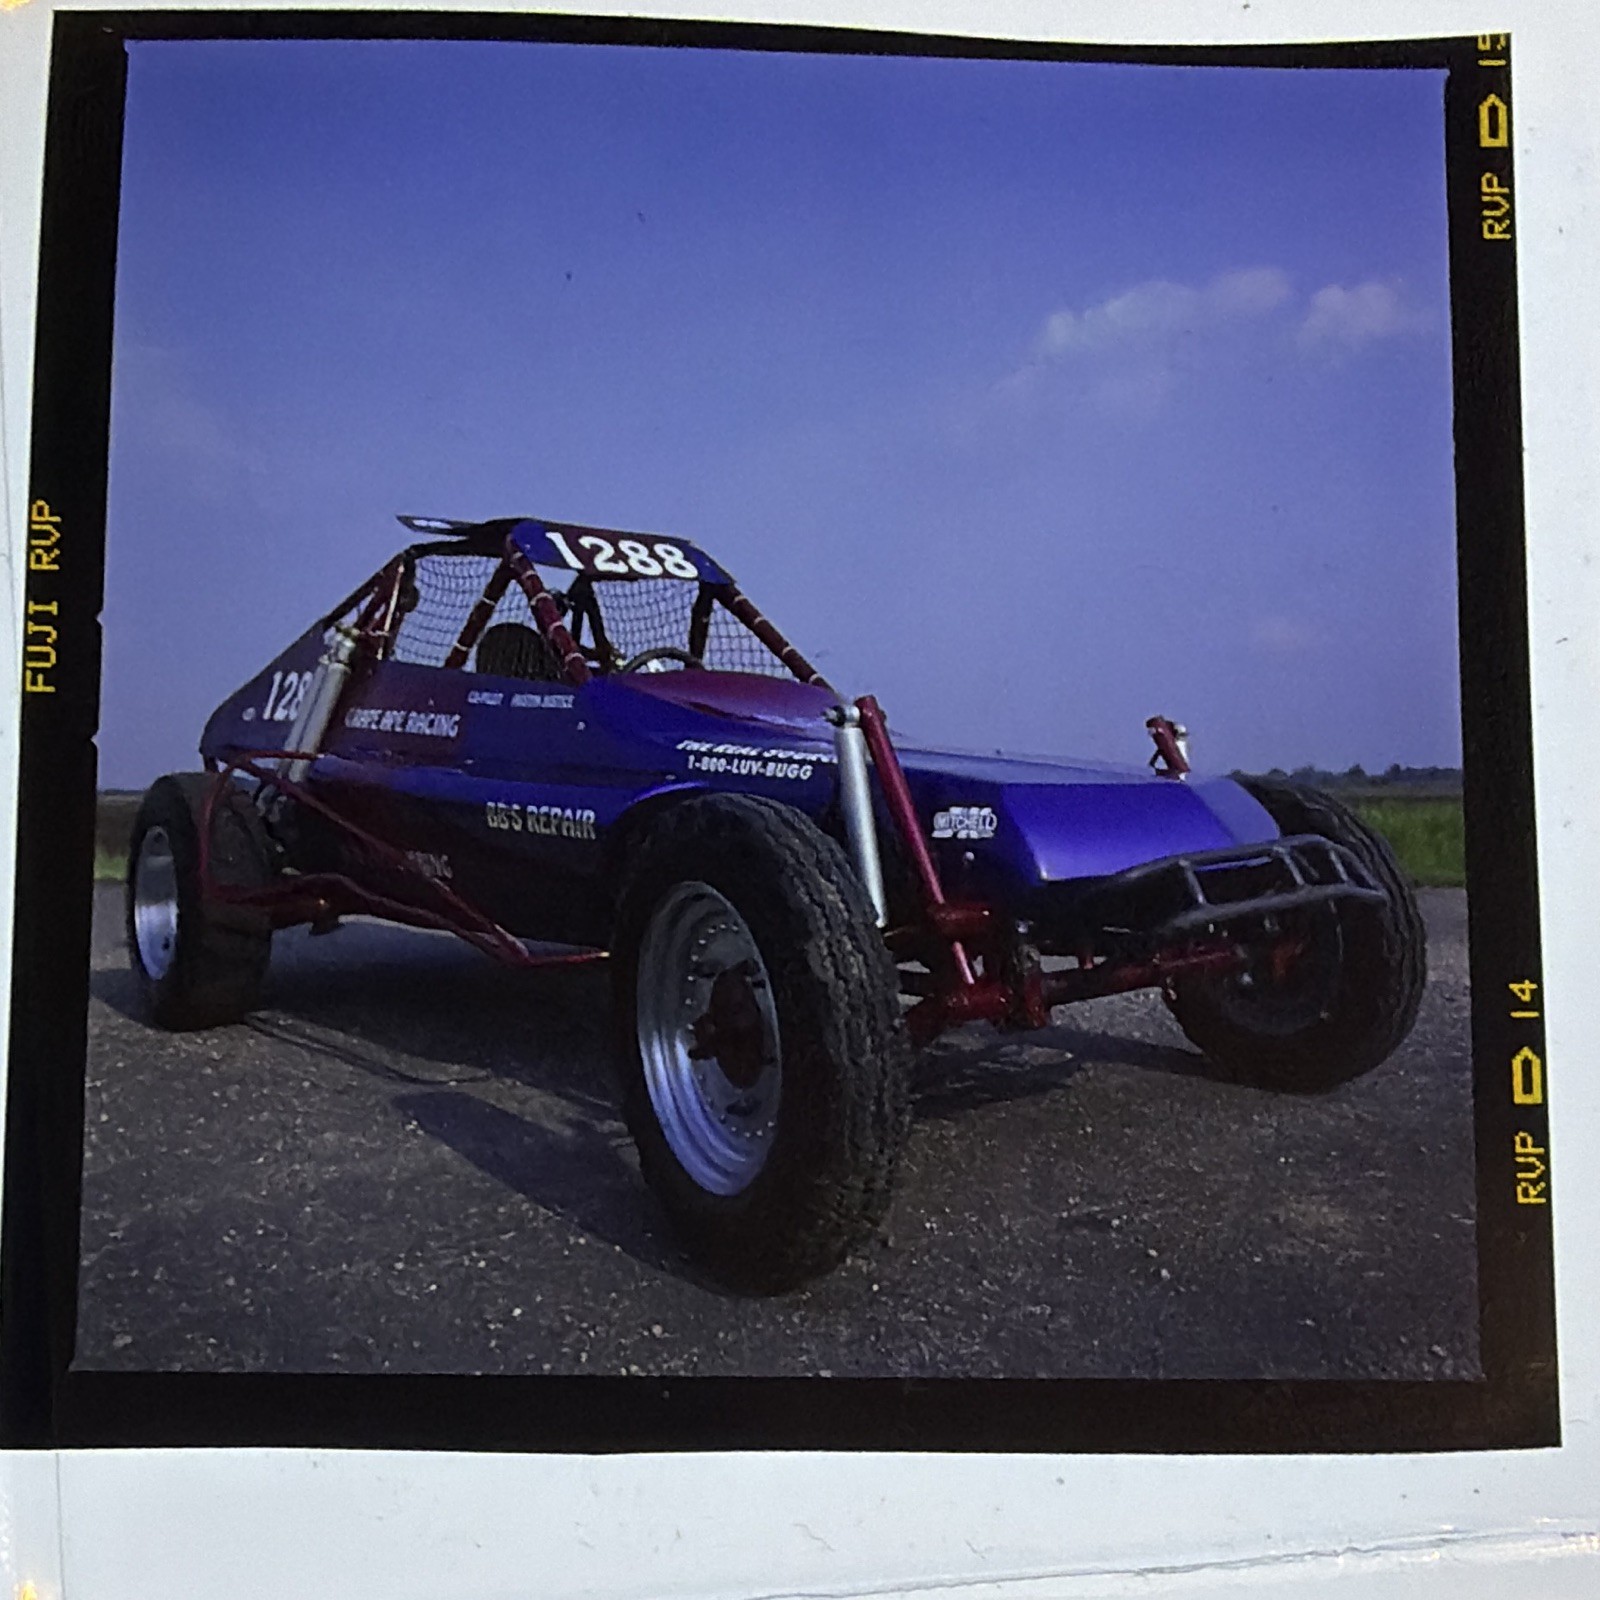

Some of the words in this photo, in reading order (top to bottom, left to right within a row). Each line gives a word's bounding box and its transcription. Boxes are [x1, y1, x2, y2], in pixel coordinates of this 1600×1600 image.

[1480, 171, 1512, 240] RVP
[29, 499, 62, 571] RVP
[545, 531, 699, 579] 1288
[25, 600, 59, 693] FUJI
[687, 754, 814, 781] 1-800-LUV-BUGG
[525, 805, 597, 840] REPAIR
[1508, 979, 1540, 1018] 14
[1514, 1130, 1547, 1205] RVP
